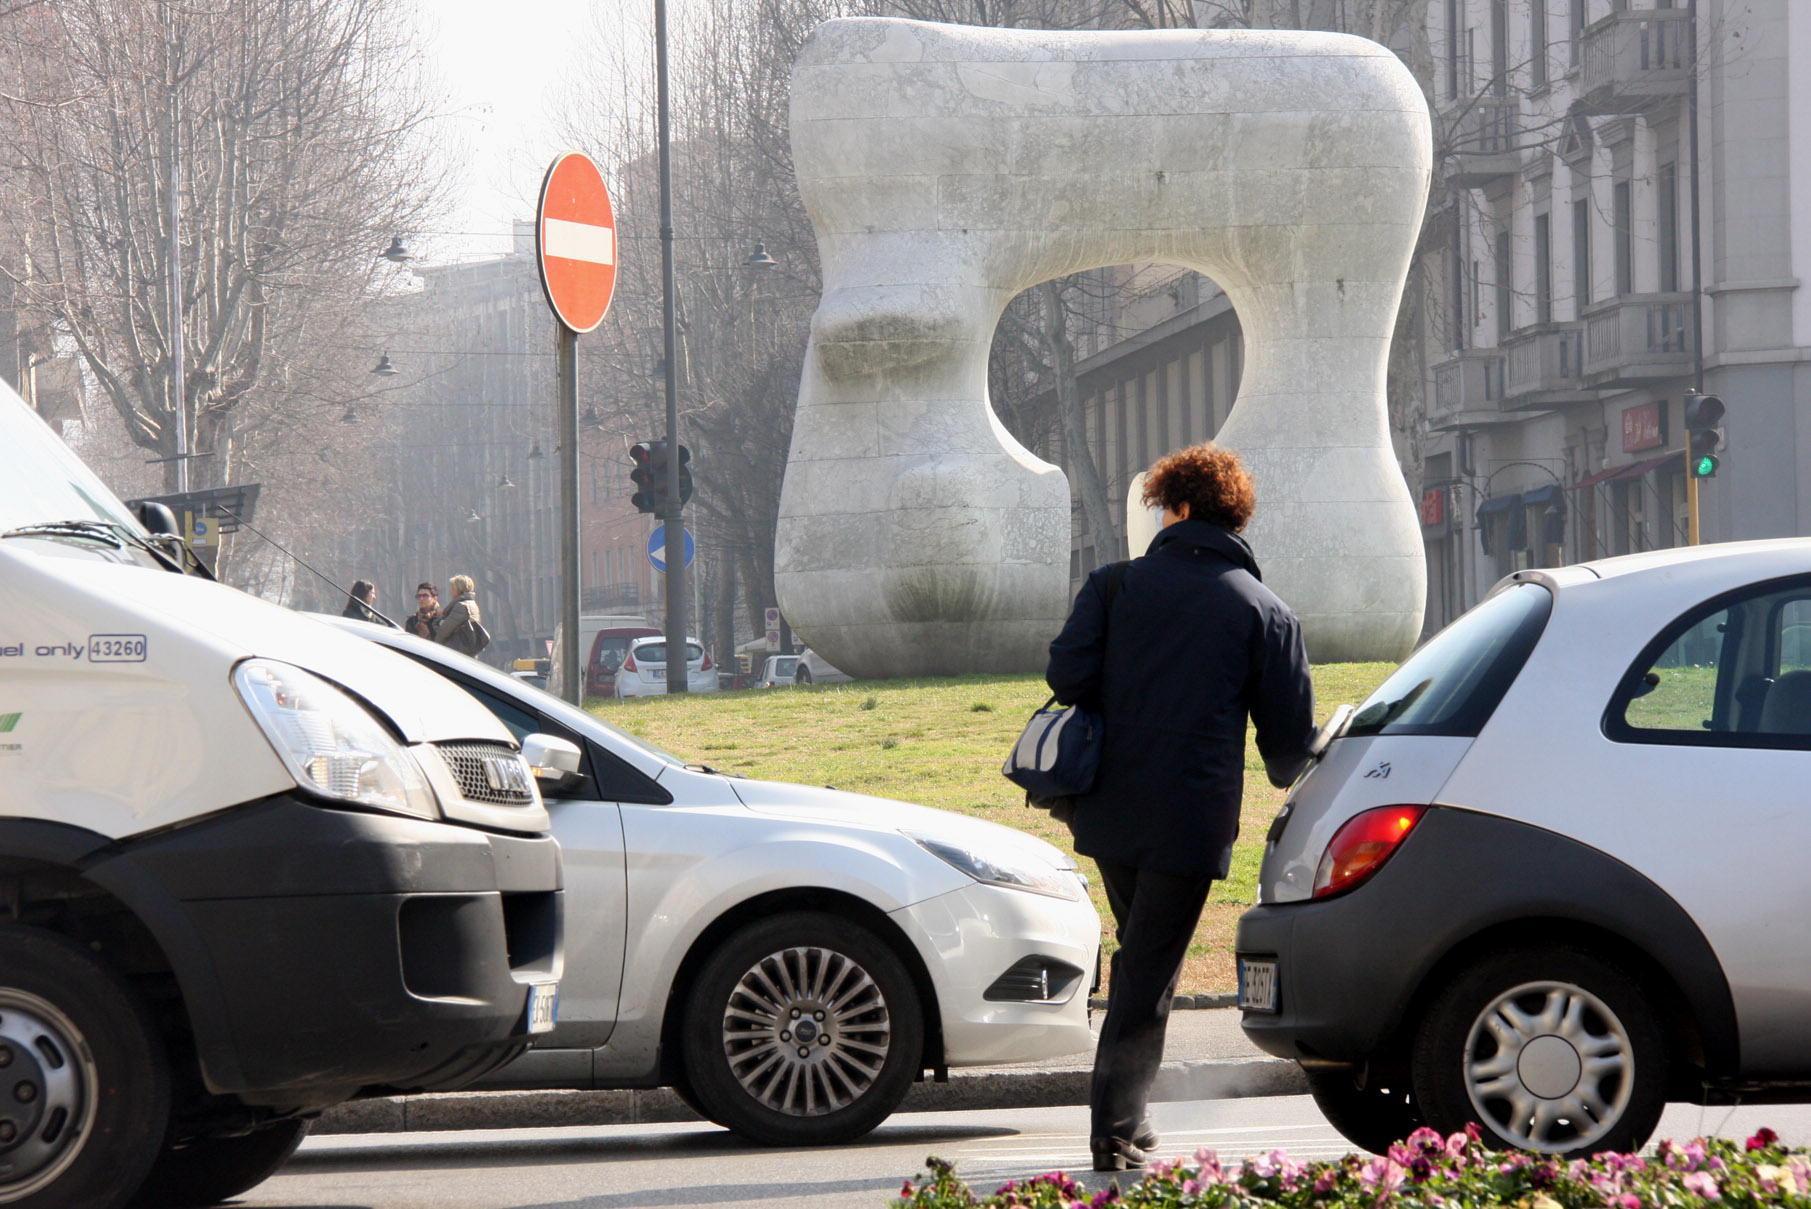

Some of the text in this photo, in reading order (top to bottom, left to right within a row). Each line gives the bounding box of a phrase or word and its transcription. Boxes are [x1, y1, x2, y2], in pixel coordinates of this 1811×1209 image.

[0, 641, 143, 660] el only 43260
